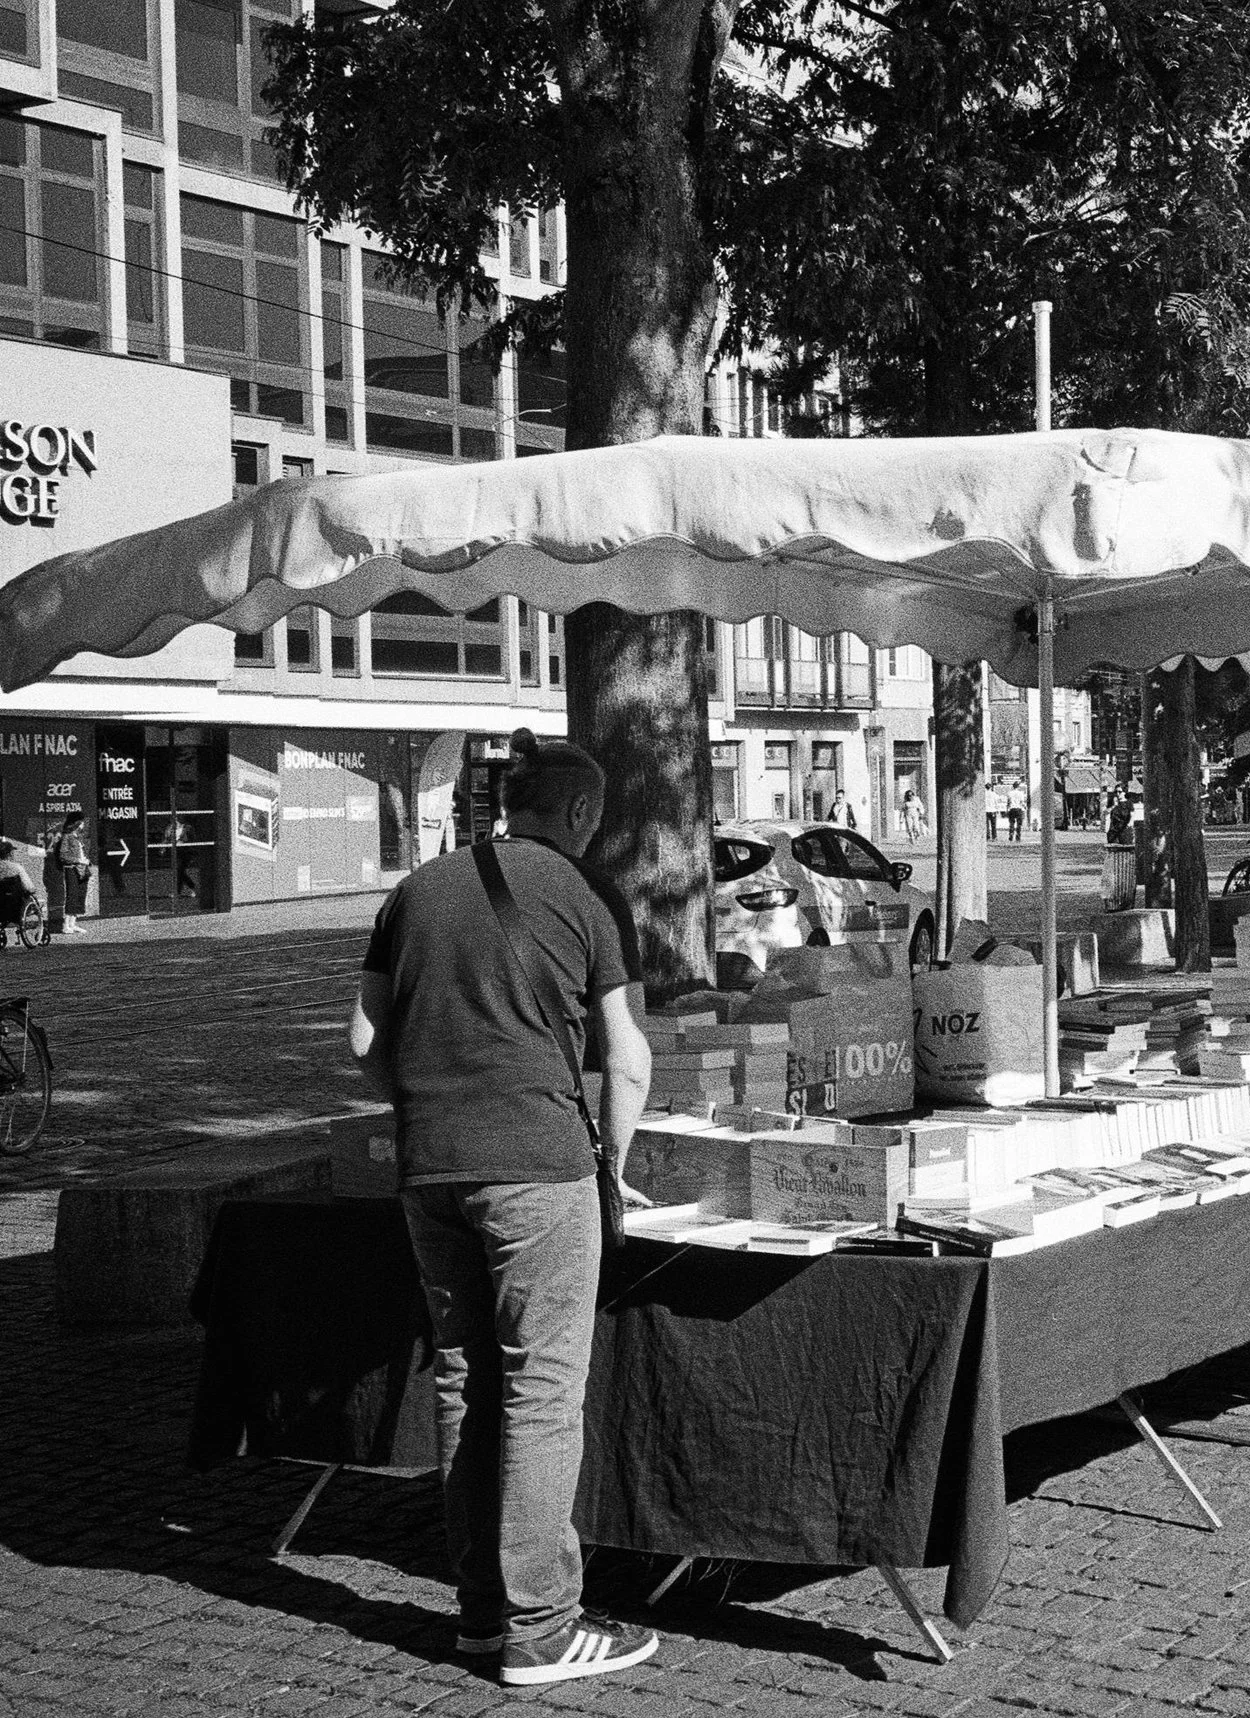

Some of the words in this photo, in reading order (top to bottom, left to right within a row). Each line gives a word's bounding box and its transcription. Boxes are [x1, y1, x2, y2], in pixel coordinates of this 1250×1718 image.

[0, 420, 99, 470] SON
[34, 735, 77, 756] FNAC
[99, 752, 135, 773] fnac
[47, 783, 76, 797] acer
[103, 784, 134, 800] ENTRÉE
[99, 806, 138, 820] MAGASIN
[931, 1012, 980, 1035] NOZ
[836, 1040, 912, 1079] 100%
